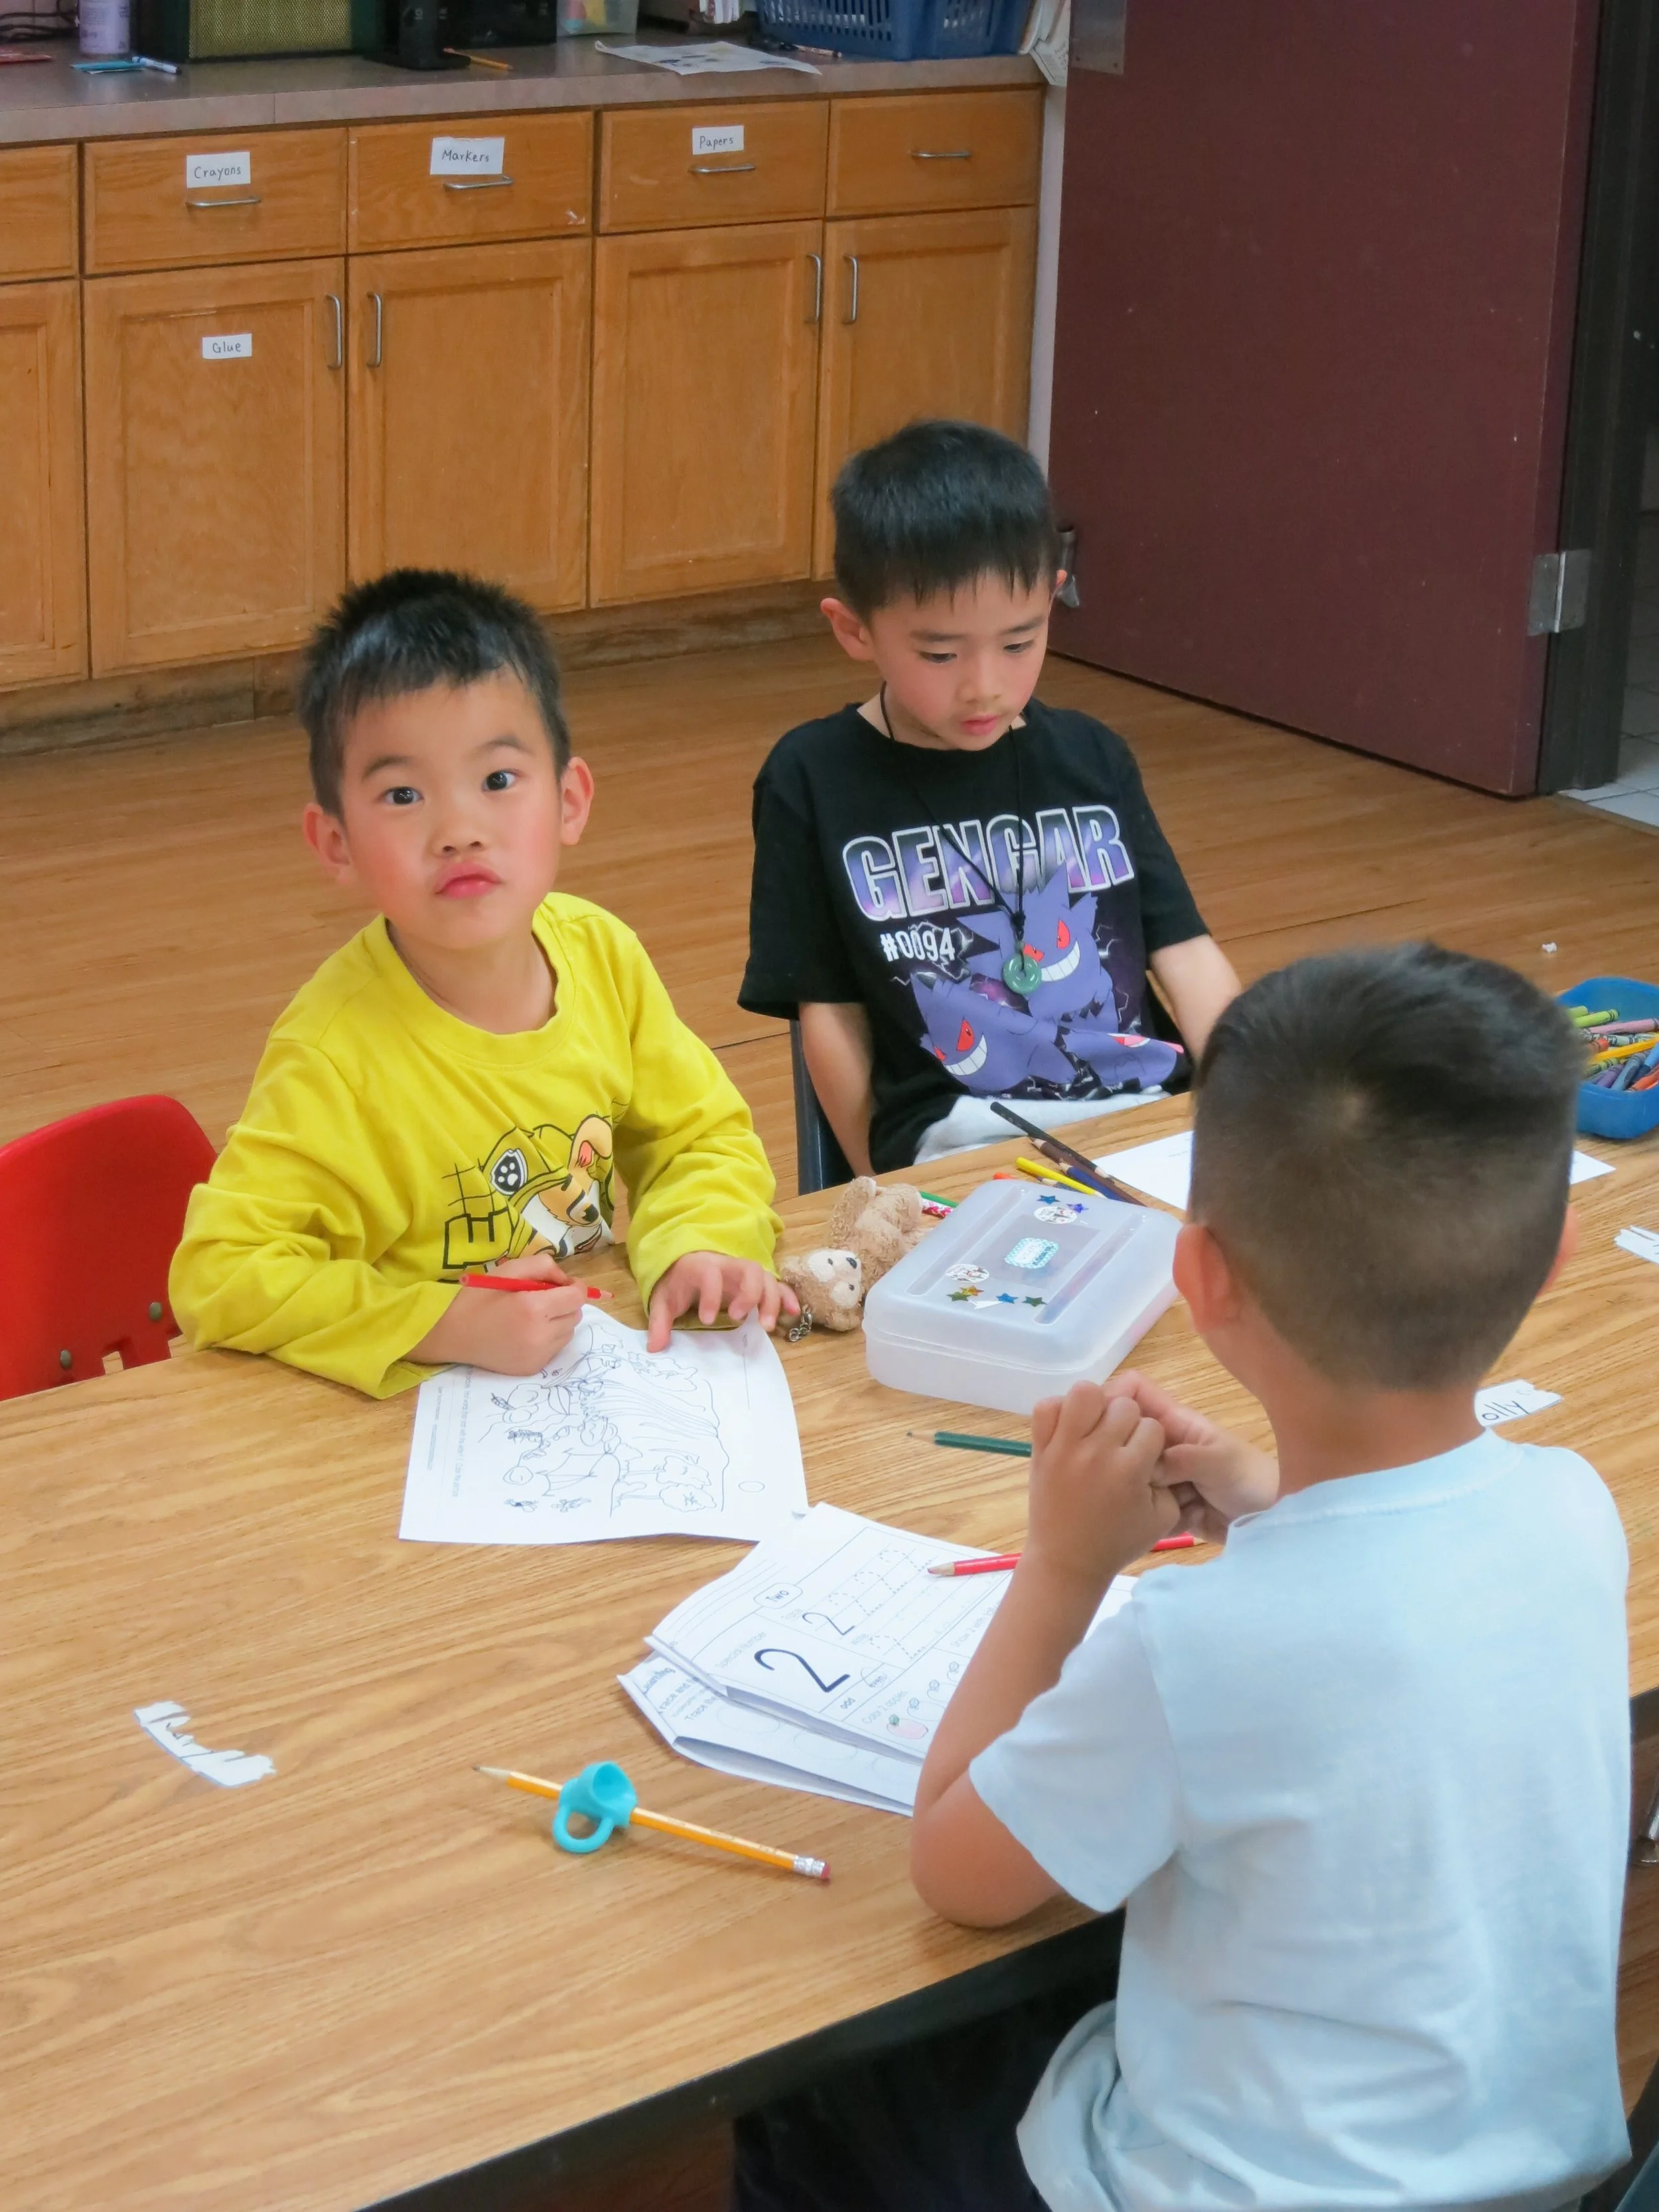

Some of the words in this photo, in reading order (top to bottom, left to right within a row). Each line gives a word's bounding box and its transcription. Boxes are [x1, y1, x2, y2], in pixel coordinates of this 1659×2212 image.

[699, 135, 734, 151] Papers
[441, 148, 490, 163] Markers
[194, 166, 242, 181] Crayons
[212, 340, 242, 353] Glue
[842, 804, 1135, 921] GENGAR
[879, 926, 956, 962] #0094
[765, 1589, 790, 1603] Two
[802, 1612, 855, 1636] 2
[754, 1648, 851, 1693] 2
[840, 1696, 856, 1710] odd
